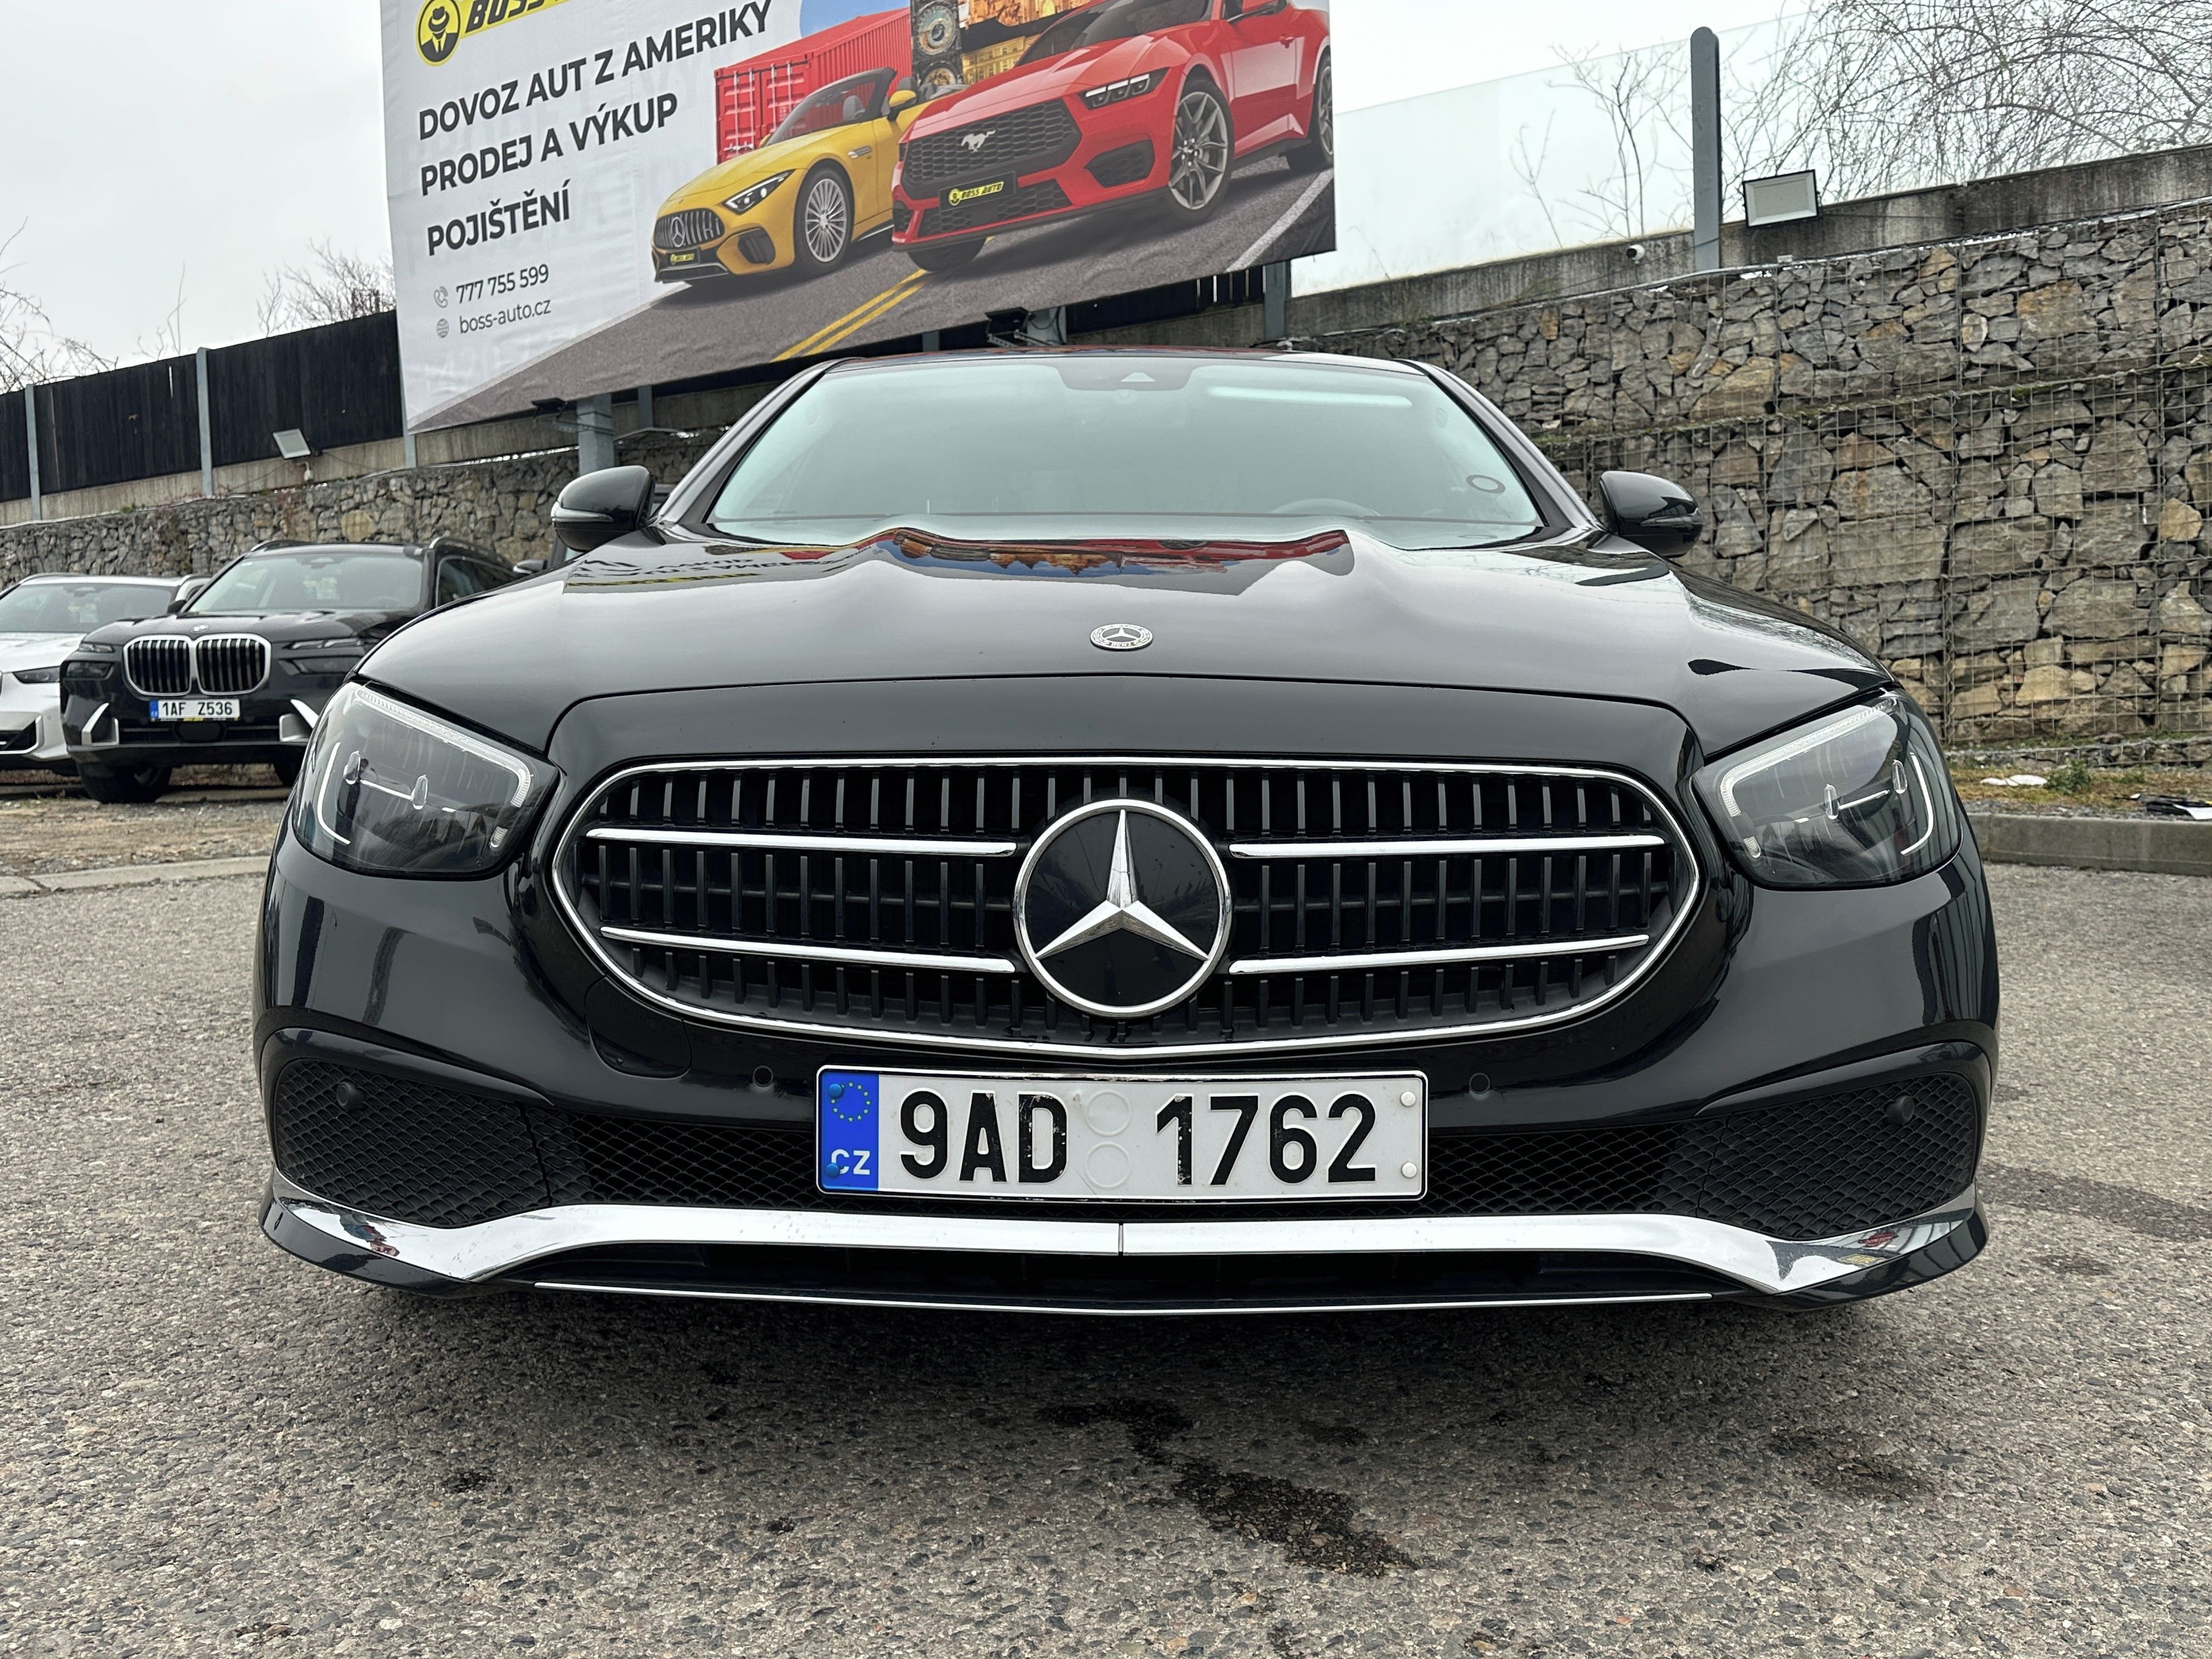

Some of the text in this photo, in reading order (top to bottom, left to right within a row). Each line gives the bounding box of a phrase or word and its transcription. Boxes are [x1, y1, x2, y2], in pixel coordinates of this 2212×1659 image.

[420, 0, 771, 140] DOVOZ AUT Z AMERIKY
[421, 92, 678, 196] PRODEJ A VÝKUP
[427, 178, 572, 257] POJIŠTĚNÍ
[456, 263, 549, 304] 777 755 599
[459, 300, 552, 334] boss-auto.cz
[162, 702, 187, 716] 1AF
[197, 702, 233, 716] Z536
[830, 1088, 1377, 1186] CZ 9AD 1762
